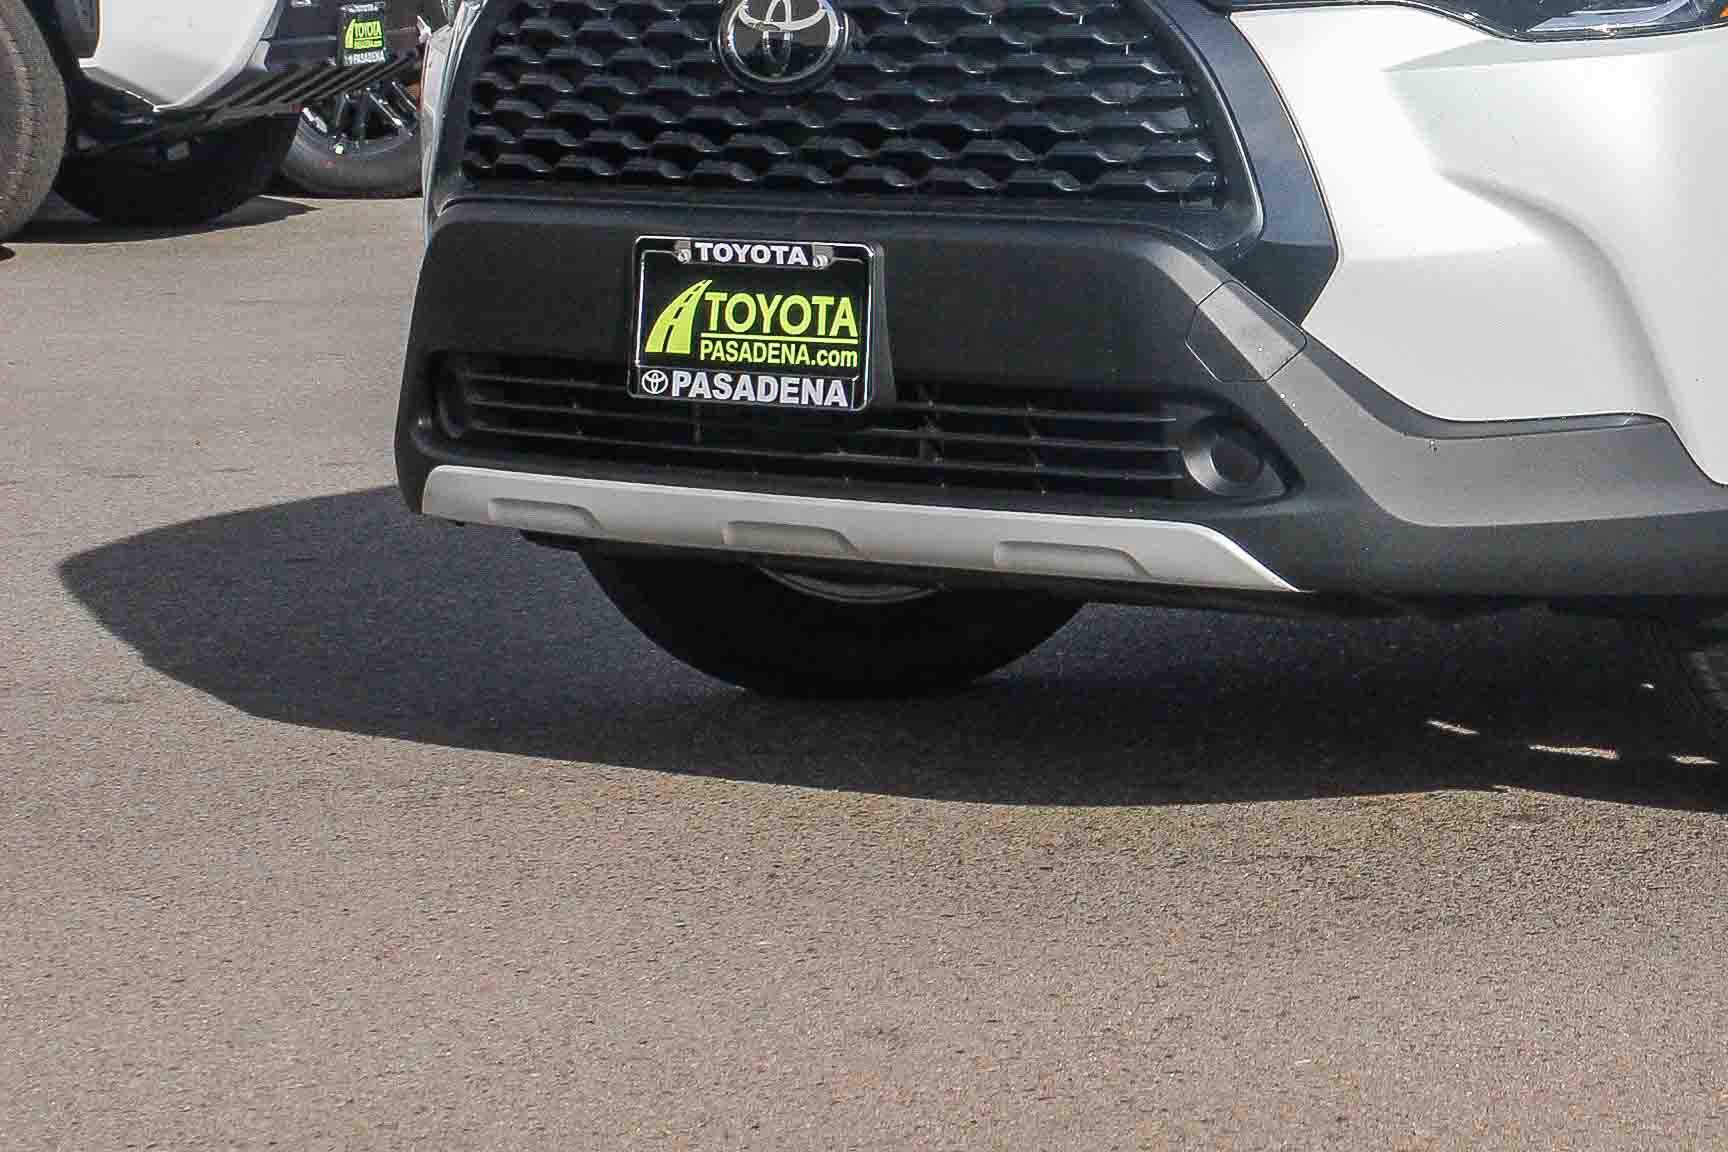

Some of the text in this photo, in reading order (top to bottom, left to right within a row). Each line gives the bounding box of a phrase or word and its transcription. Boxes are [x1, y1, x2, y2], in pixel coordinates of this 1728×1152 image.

[353, 21, 383, 38] TOYOTA
[695, 242, 809, 266] TOYOTA
[704, 292, 859, 337] TOYOTA
[699, 339, 858, 367] PASADENA.com
[671, 370, 849, 407] PASADENA
